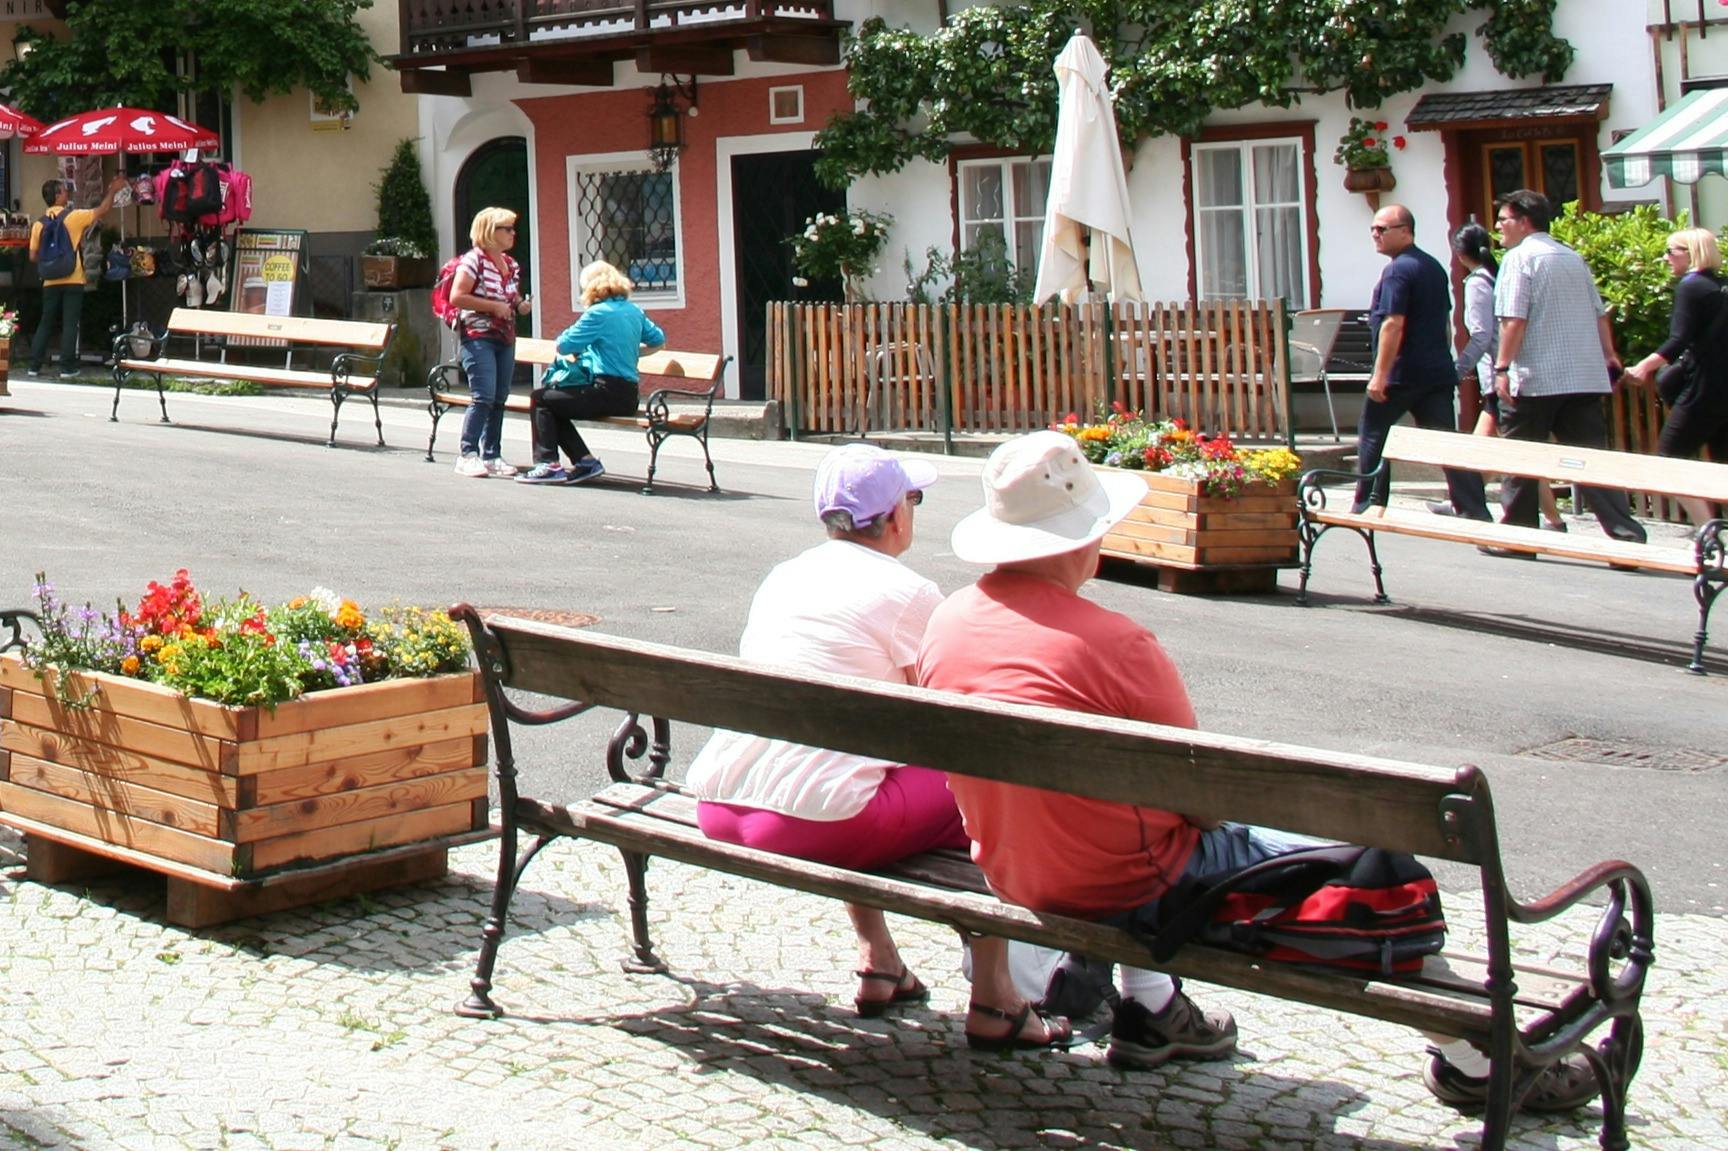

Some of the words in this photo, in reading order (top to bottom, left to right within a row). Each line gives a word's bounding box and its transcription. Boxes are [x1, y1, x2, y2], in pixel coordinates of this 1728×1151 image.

[56, 142, 88, 152] Julius
[90, 141, 118, 151] Meinl
[127, 142, 158, 152] Julius
[159, 140, 188, 150] Meinl
[264, 262, 291, 272] COFFEE
[265, 273, 276, 282] TO
[277, 273, 289, 282] GO
